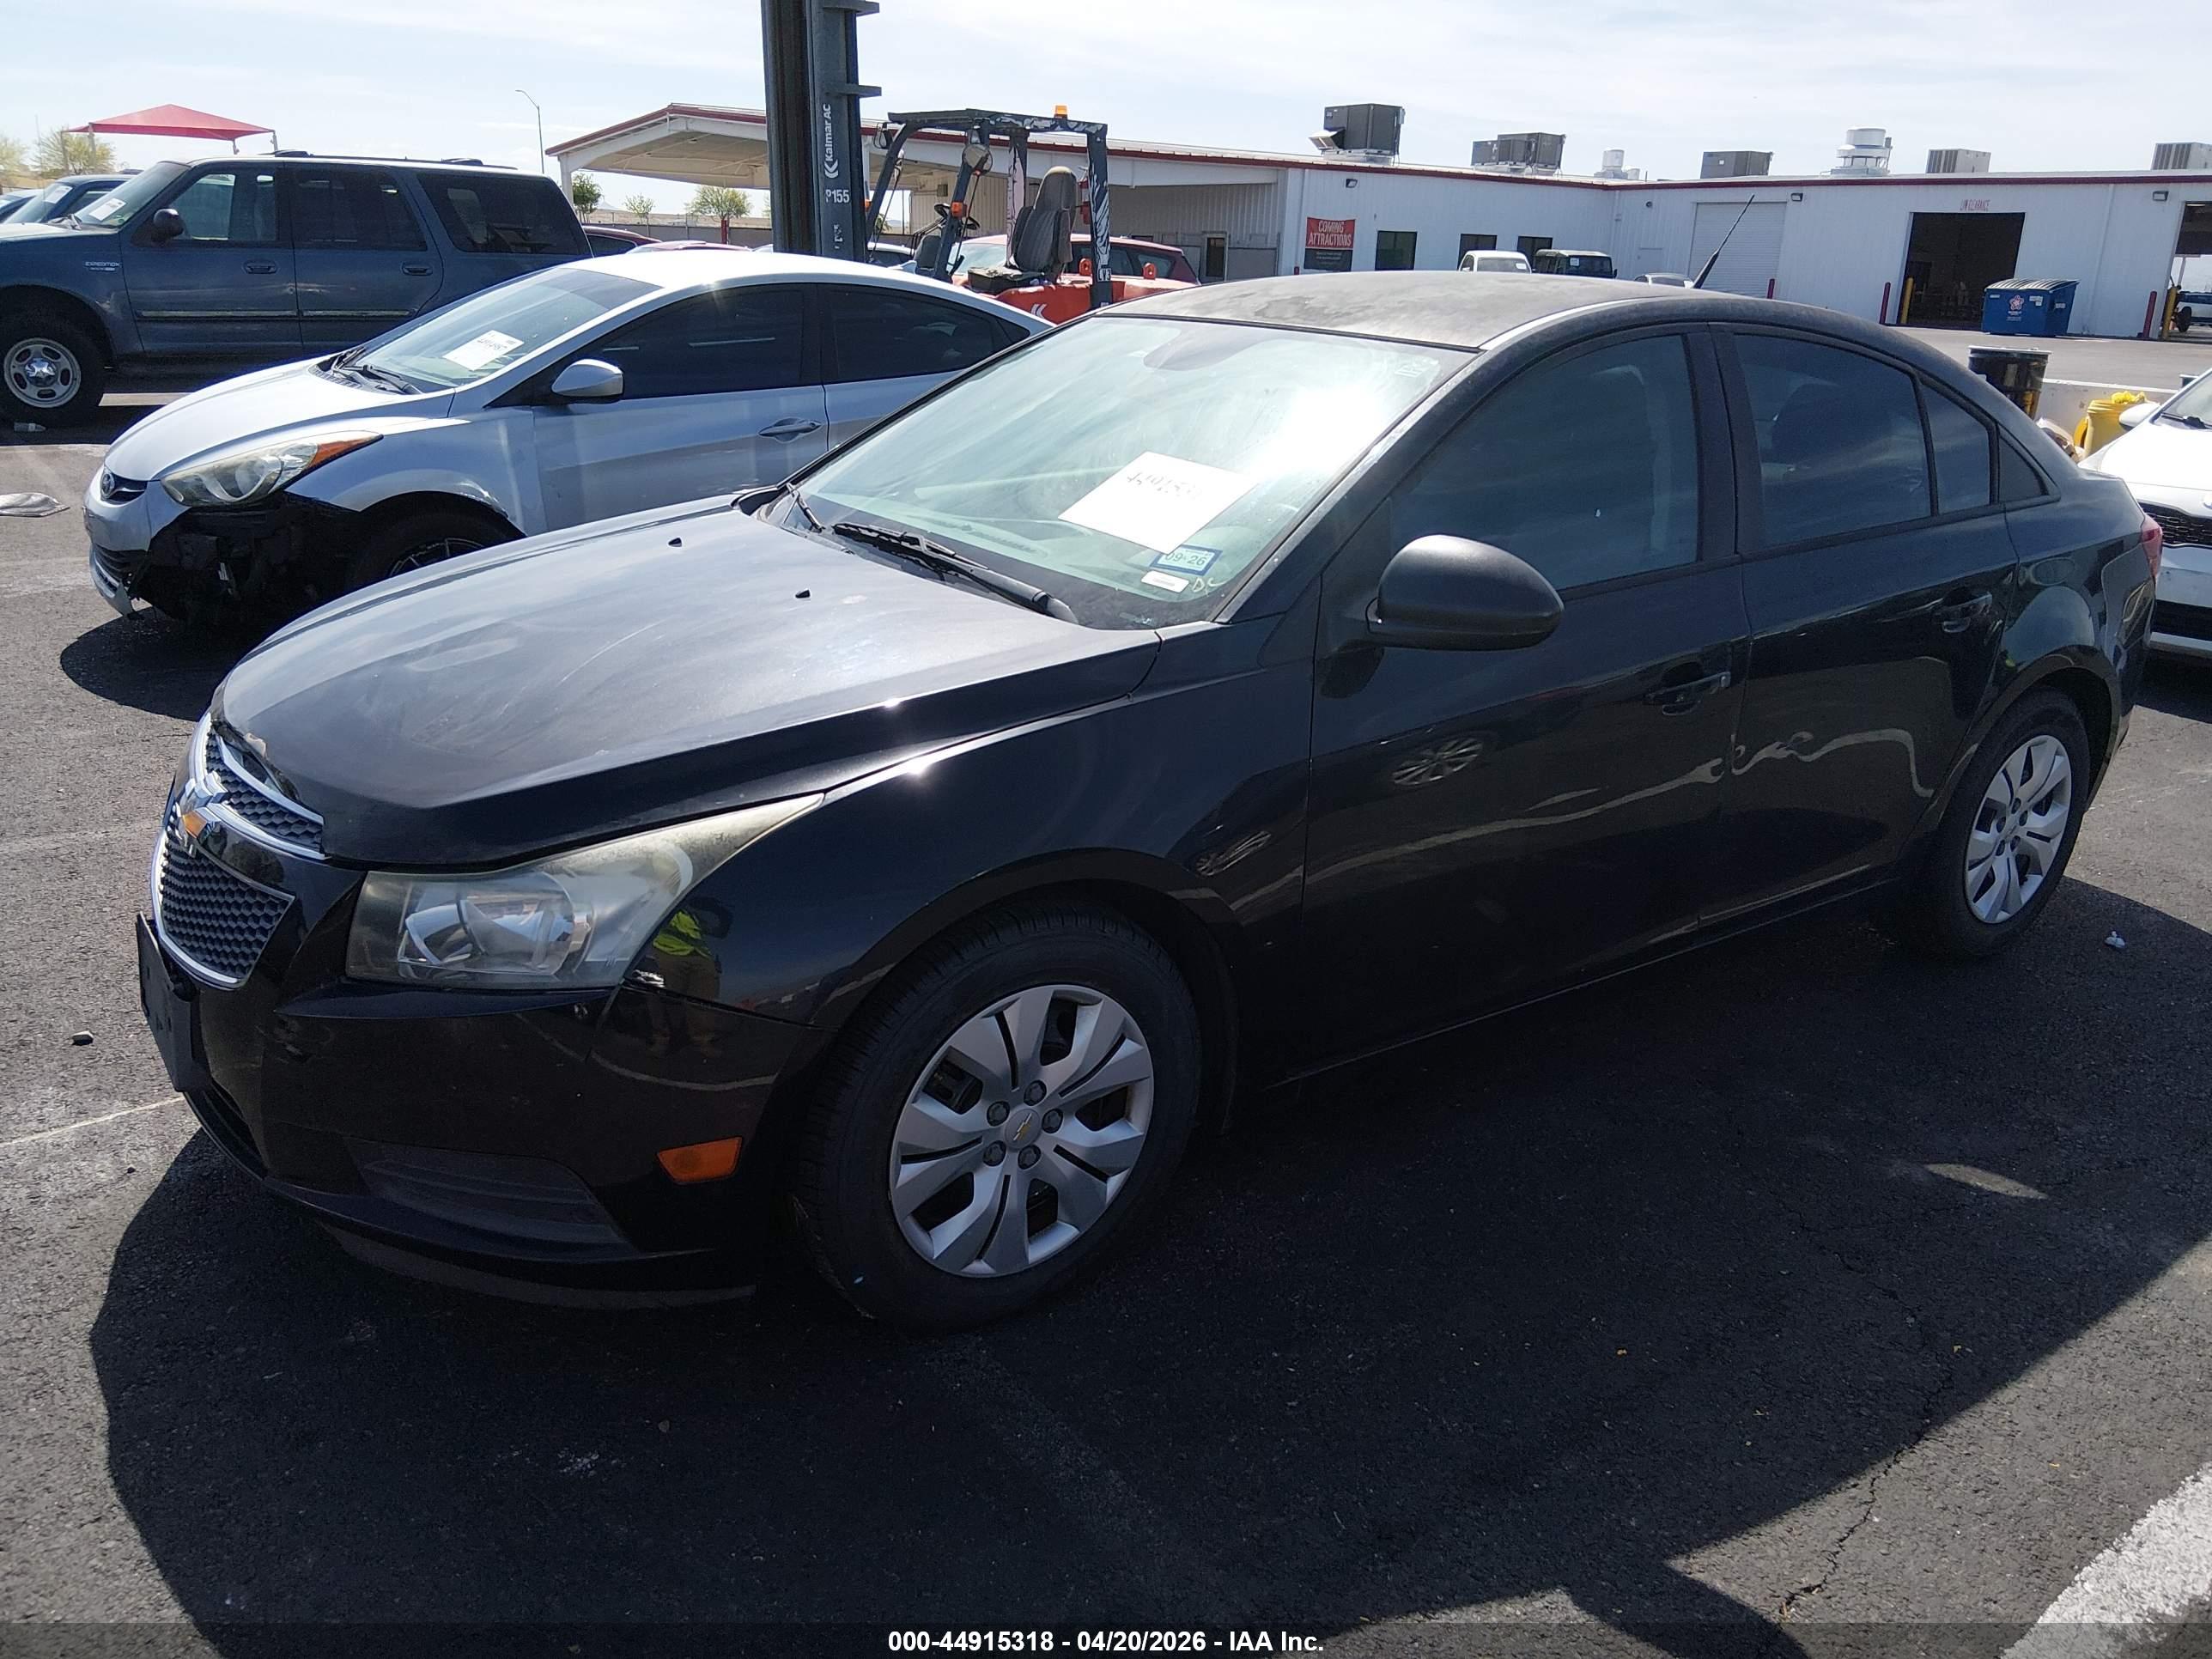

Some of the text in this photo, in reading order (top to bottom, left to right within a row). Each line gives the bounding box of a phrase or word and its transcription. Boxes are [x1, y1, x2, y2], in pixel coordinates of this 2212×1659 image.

[823, 103, 834, 162] Kalmar AC
[1318, 220, 1345, 234] COMING
[1308, 232, 1352, 247] ATTRACTIONS
